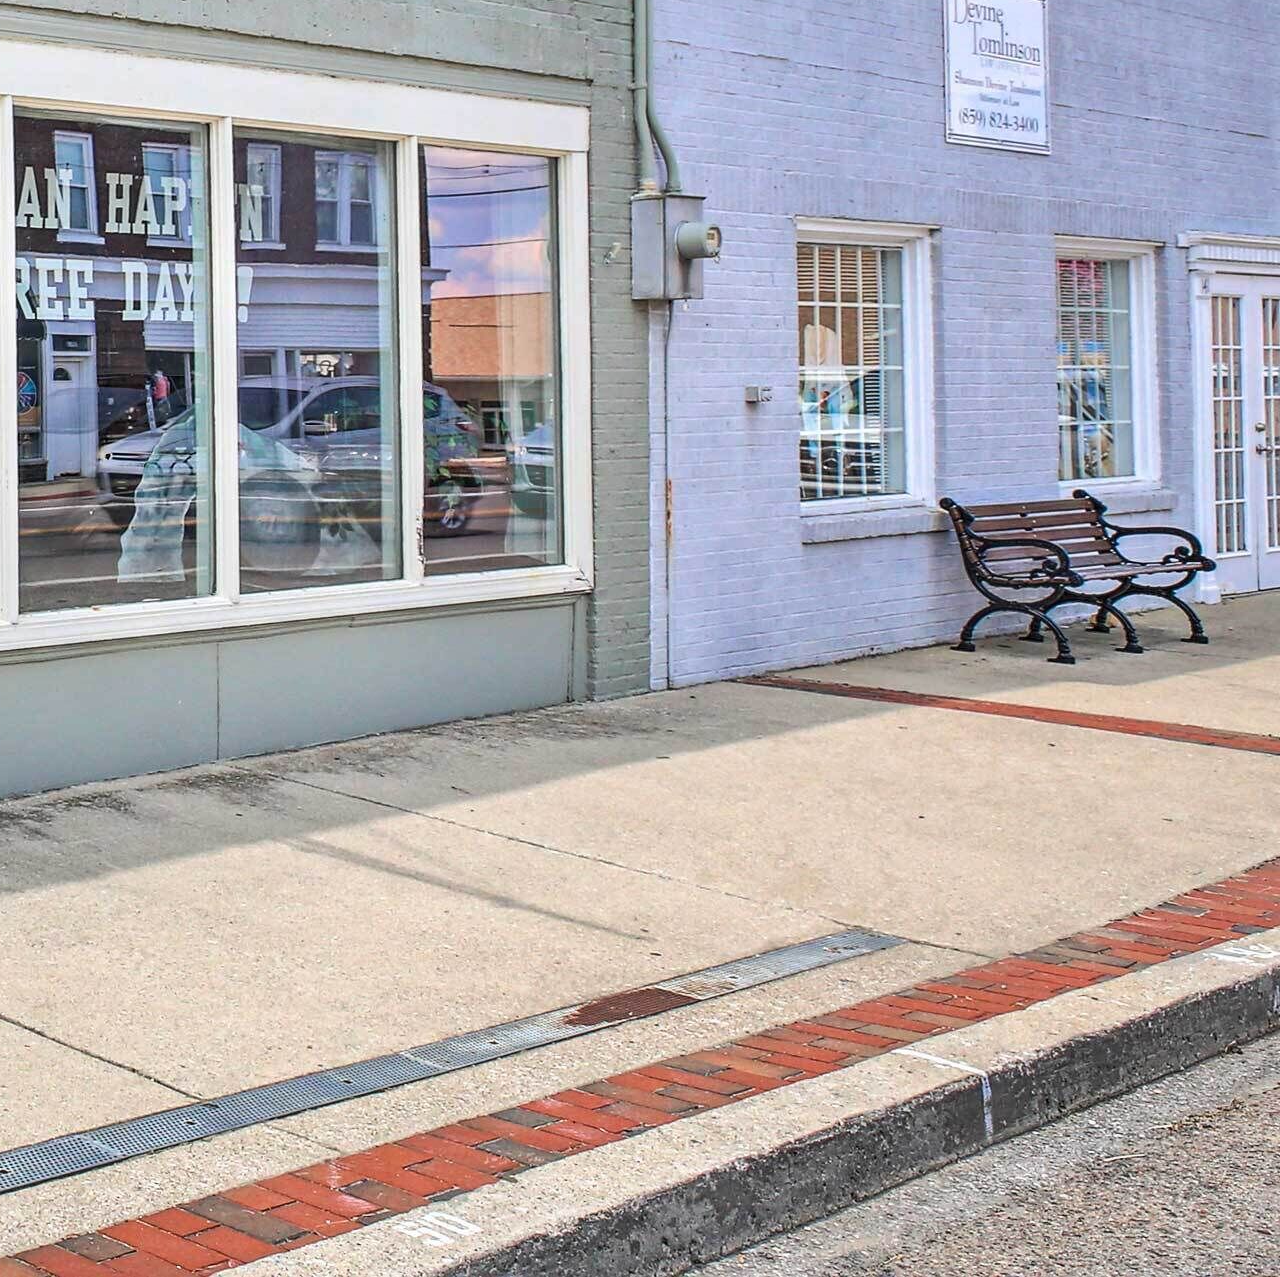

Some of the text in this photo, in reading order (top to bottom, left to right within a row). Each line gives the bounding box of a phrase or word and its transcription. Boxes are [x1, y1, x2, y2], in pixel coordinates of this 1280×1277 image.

[968, 20, 1040, 62] Tomlinson
[959, 108, 1039, 133] (859) 824-3400
[16, 166, 73, 229] AN
[105, 172, 264, 241] HAPN
[122, 261, 254, 323] DAY!
